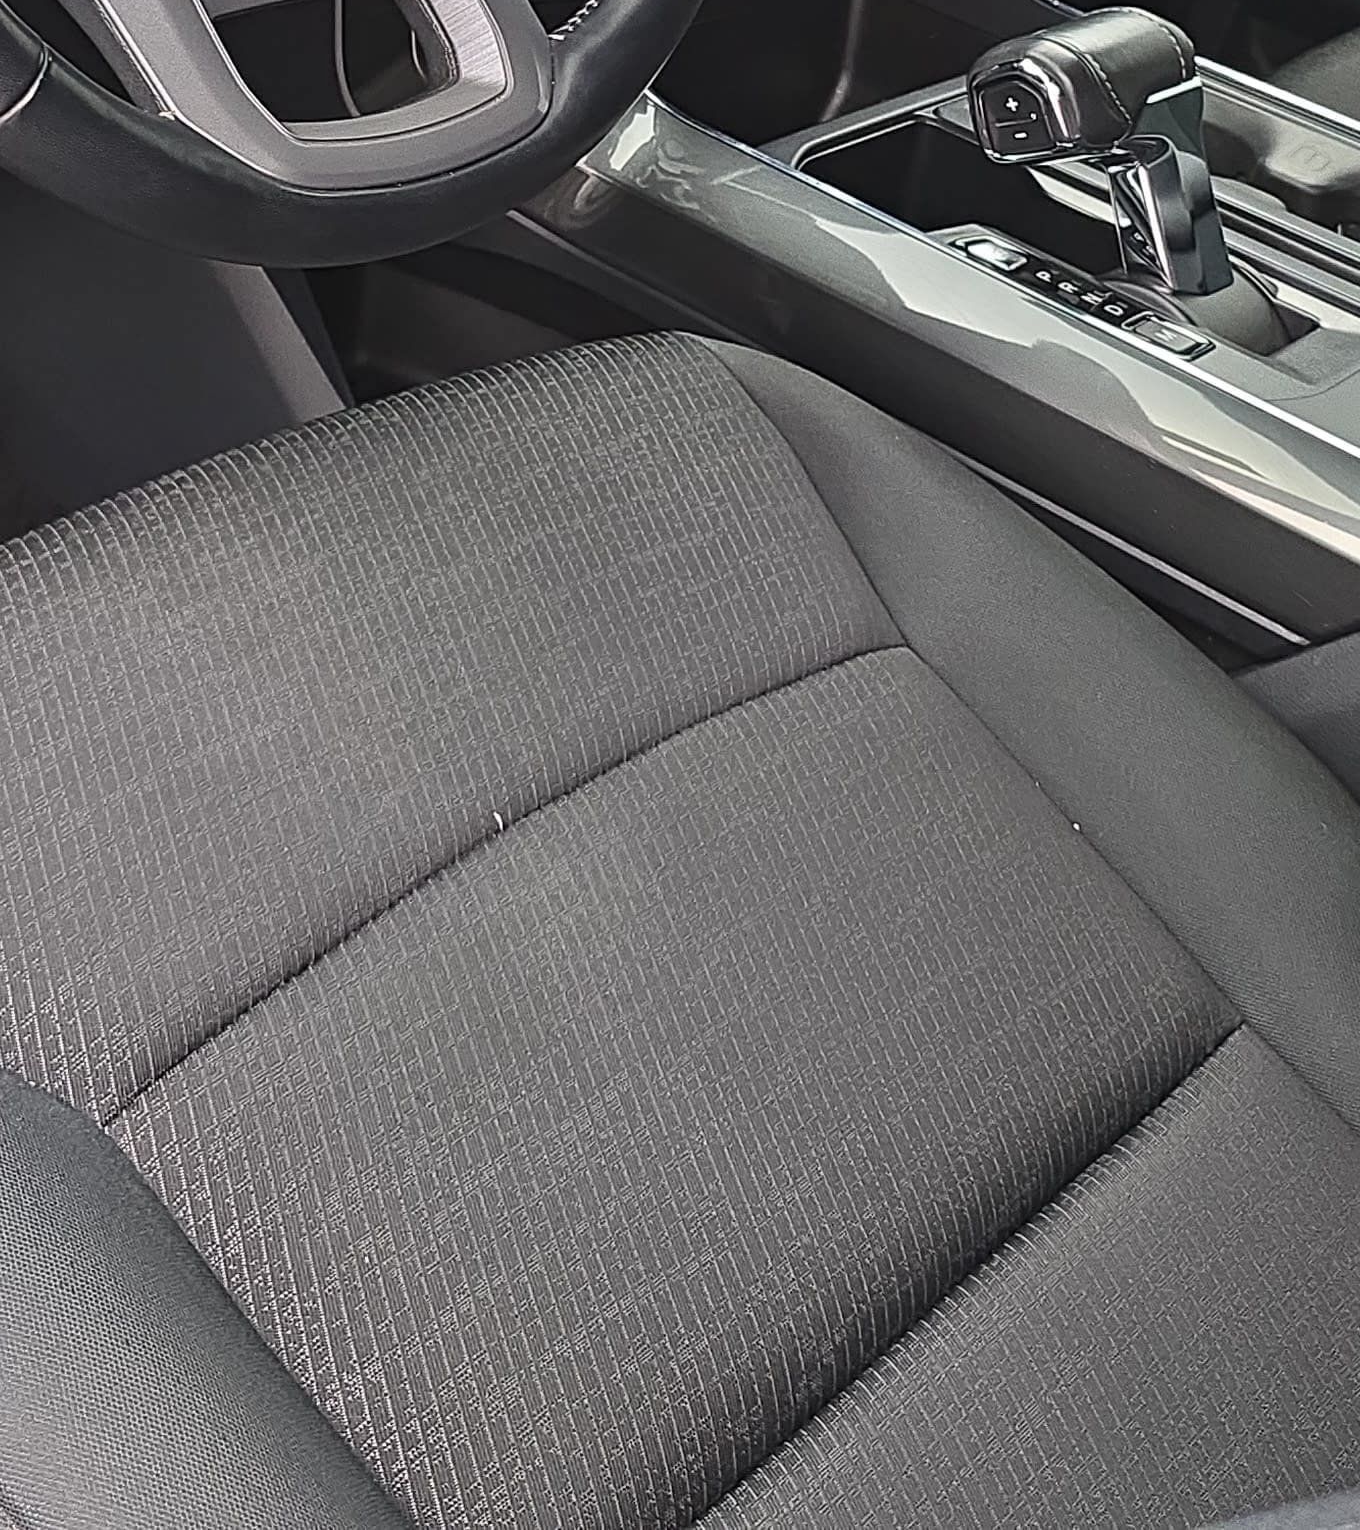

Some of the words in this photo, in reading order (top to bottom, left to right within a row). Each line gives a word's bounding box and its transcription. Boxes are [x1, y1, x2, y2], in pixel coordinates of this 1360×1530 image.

[1035, 270, 1052, 283] P
[1058, 281, 1078, 294] R
[1103, 304, 1124, 317] D
